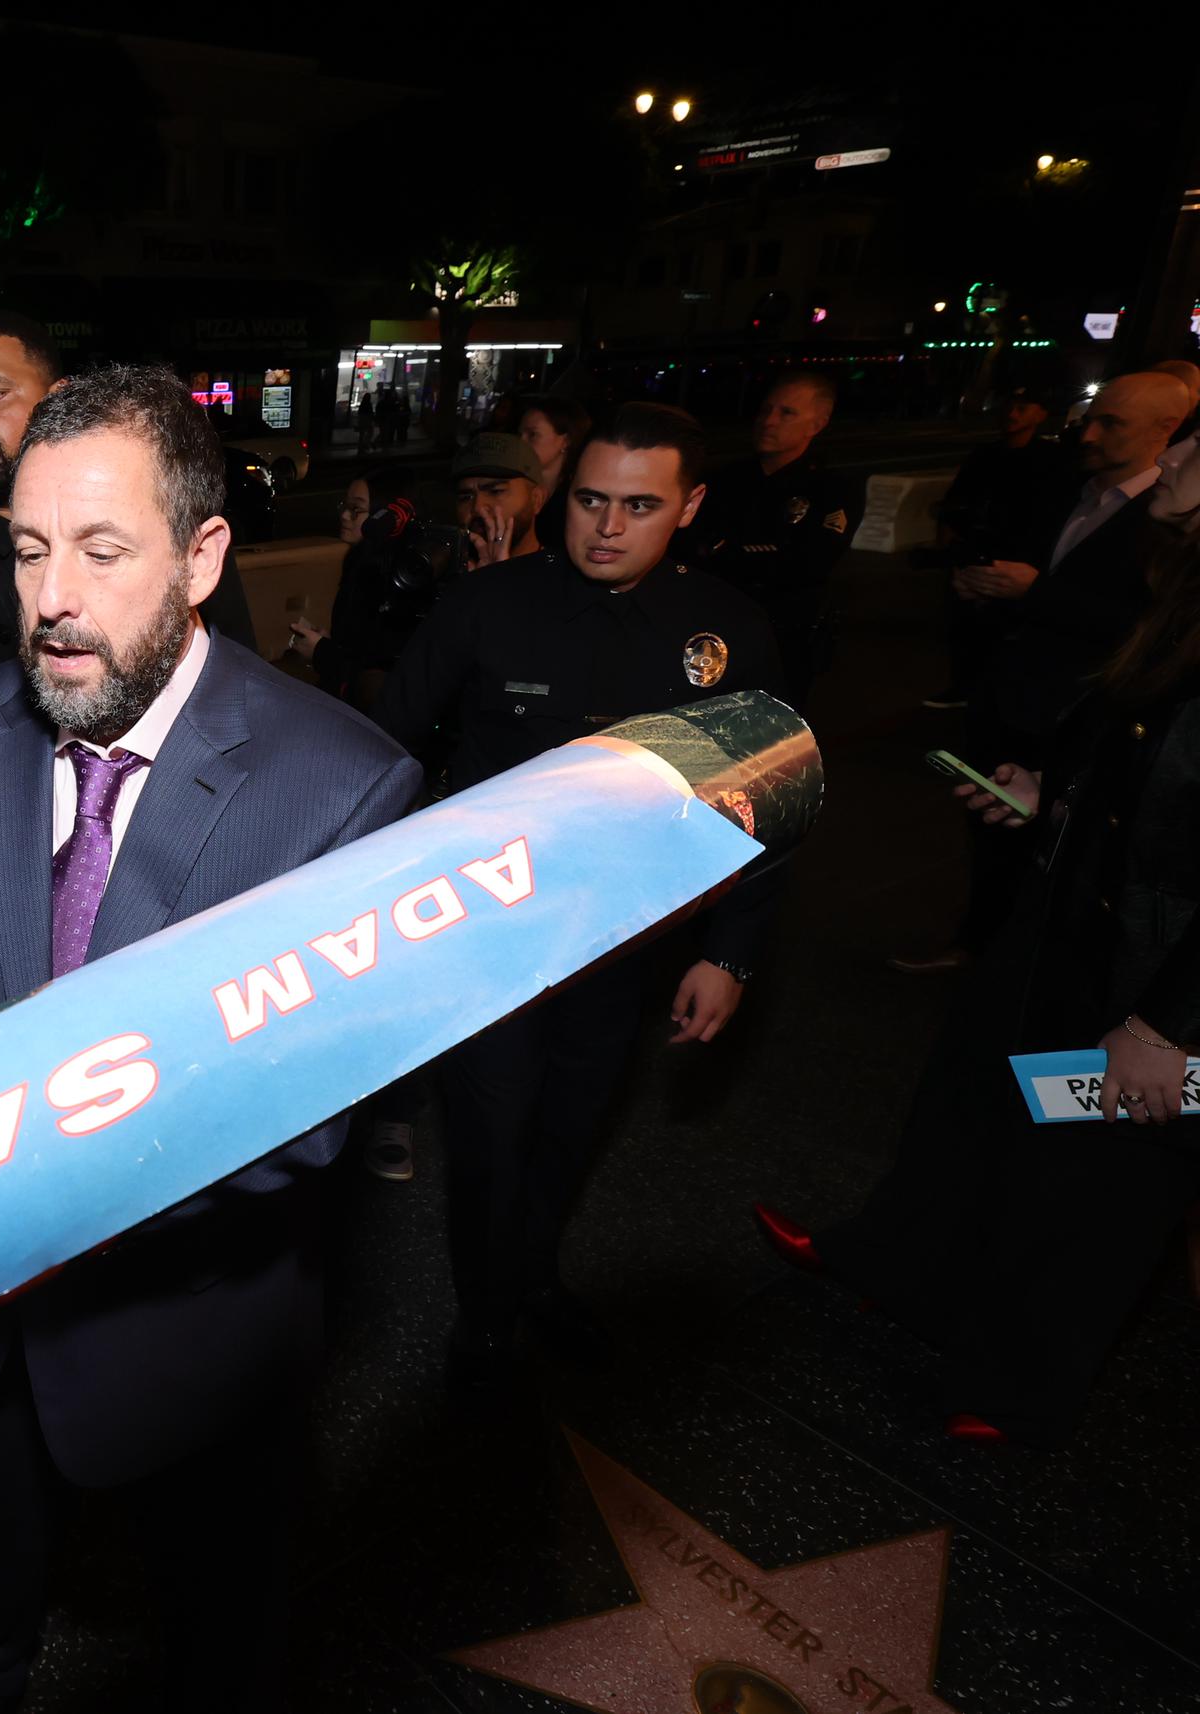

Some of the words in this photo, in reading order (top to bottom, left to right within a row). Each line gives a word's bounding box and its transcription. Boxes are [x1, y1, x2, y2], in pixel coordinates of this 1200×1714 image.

[195, 319, 248, 338] PIZZA
[252, 318, 308, 338] WORX
[212, 836, 534, 1043] ADAM
[621, 1503, 823, 1663] SYLVESTER
